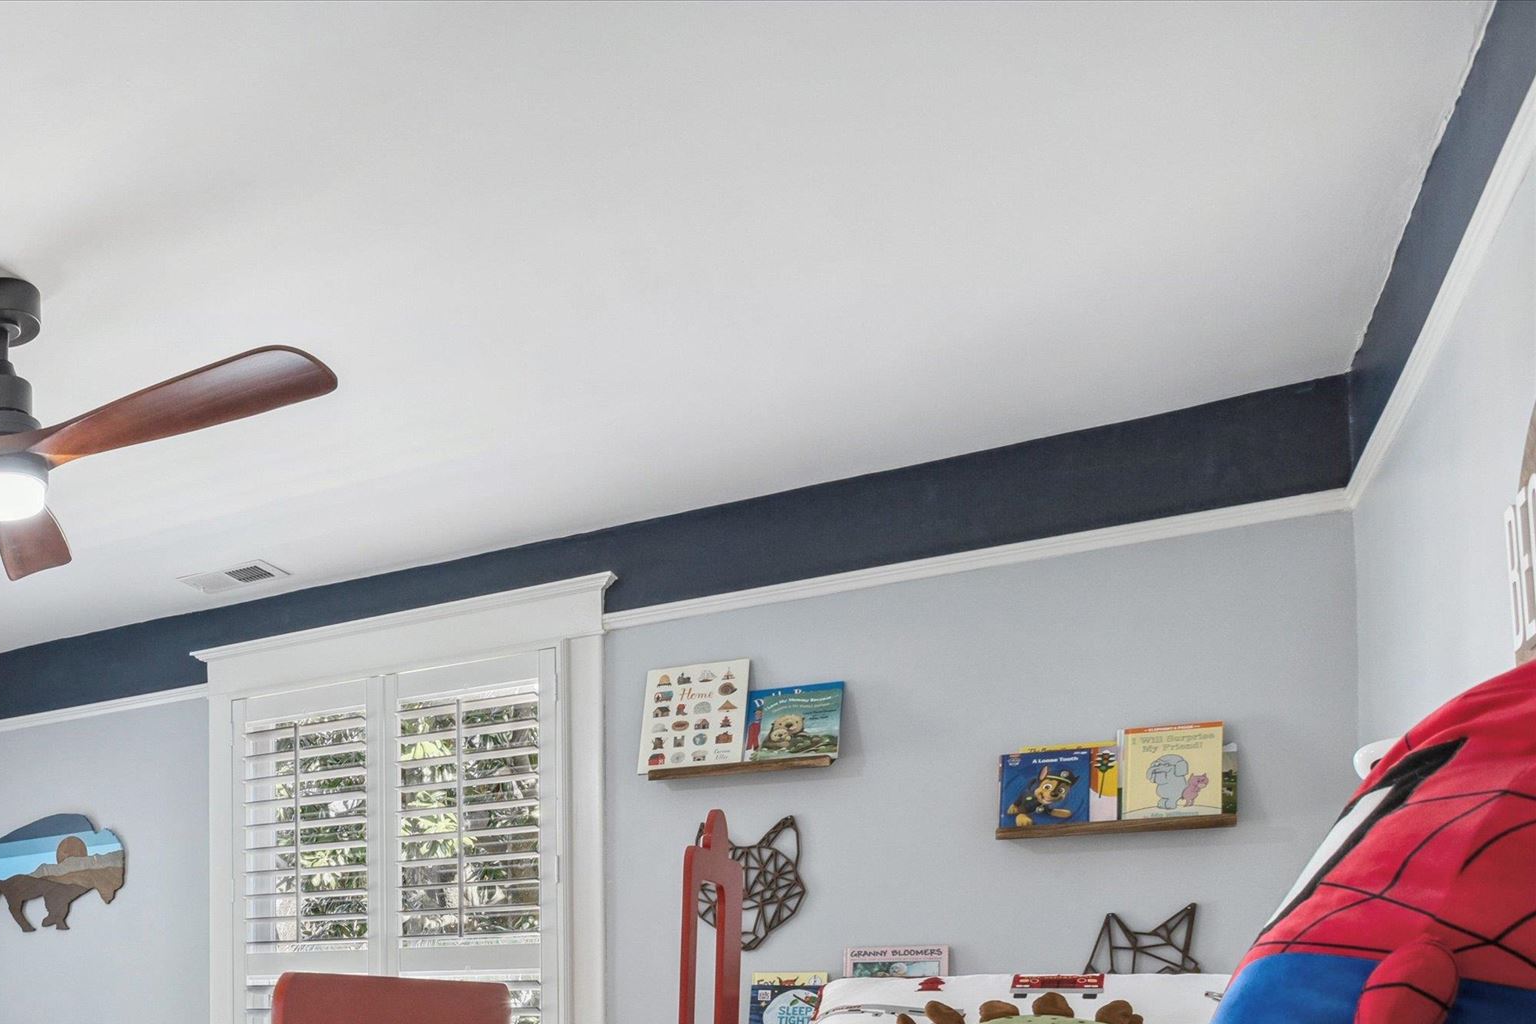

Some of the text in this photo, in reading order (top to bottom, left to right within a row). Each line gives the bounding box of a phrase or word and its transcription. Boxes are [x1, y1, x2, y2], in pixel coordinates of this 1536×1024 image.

[679, 687, 714, 700] Home
[1140, 736, 1163, 744] Will
[1167, 733, 1215, 743] Surprise
[1142, 741, 1204, 753] My Friend!
[891, 948, 943, 956] BLOOMERS
[778, 1006, 812, 1016] SLEEP
